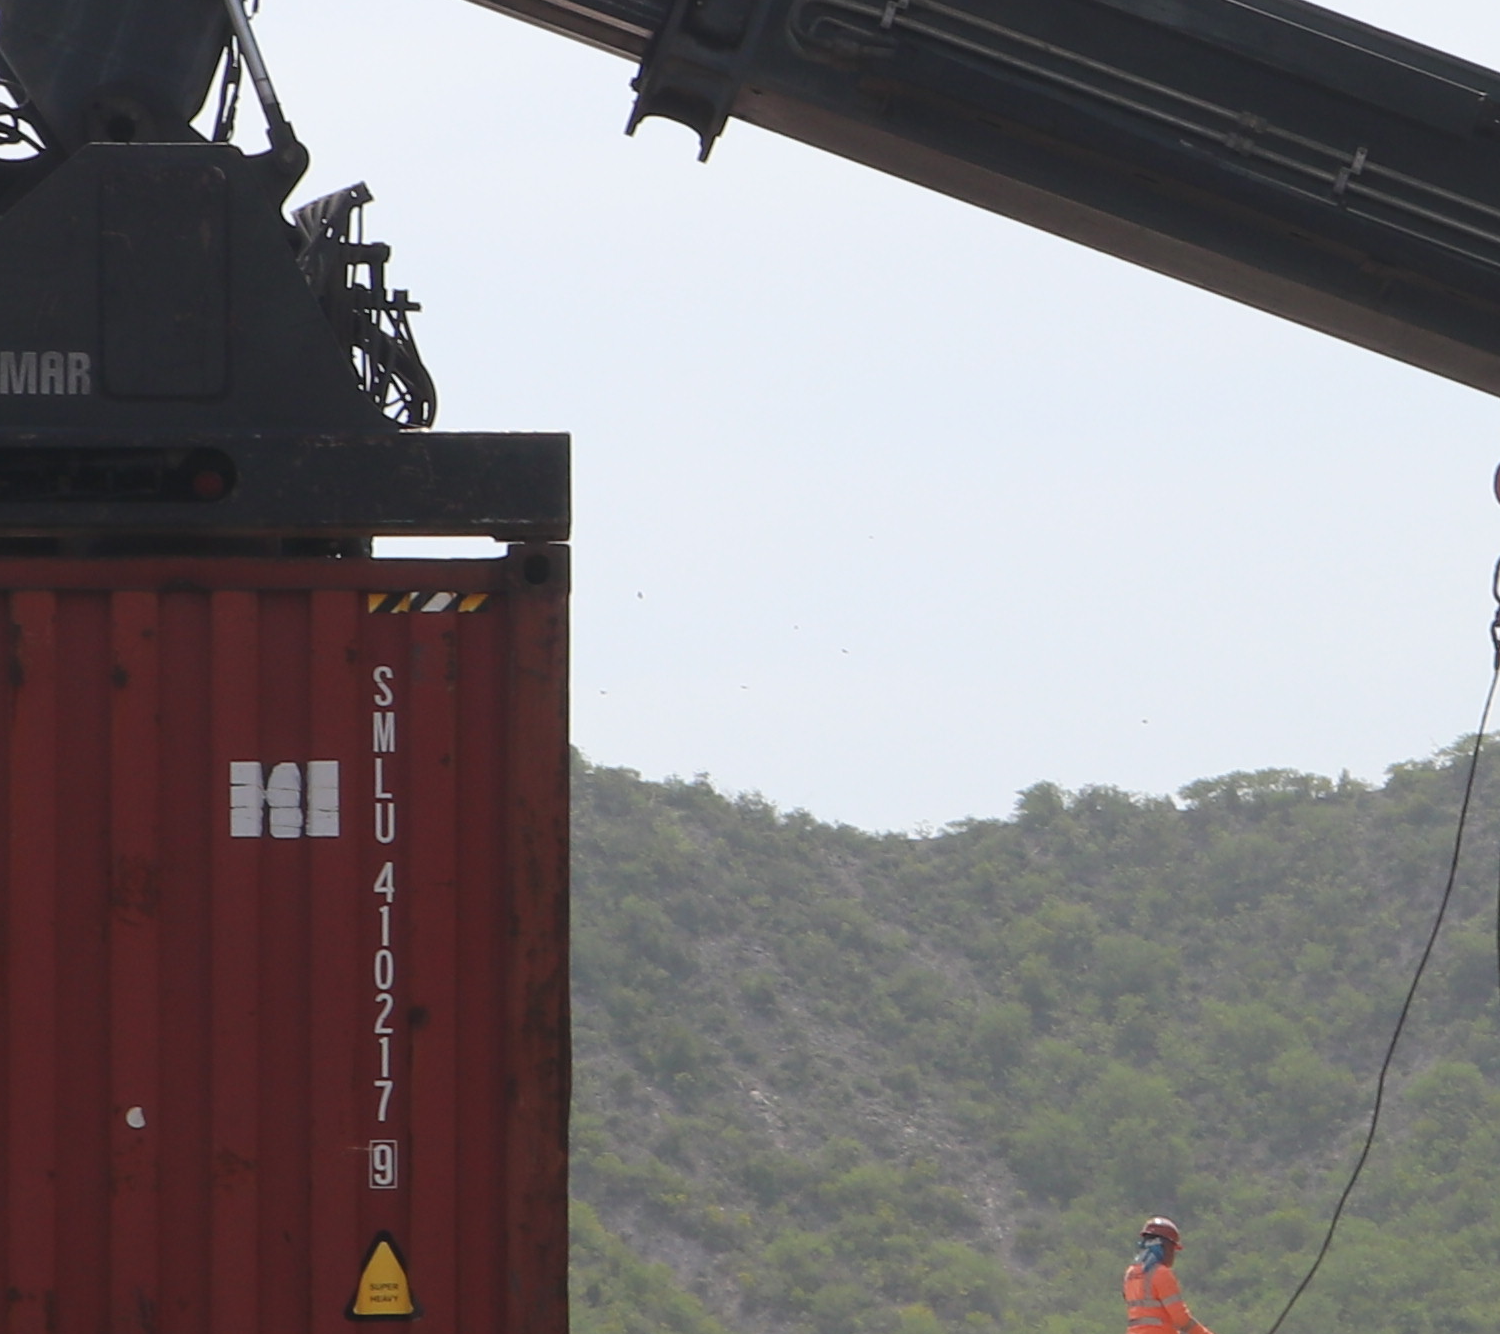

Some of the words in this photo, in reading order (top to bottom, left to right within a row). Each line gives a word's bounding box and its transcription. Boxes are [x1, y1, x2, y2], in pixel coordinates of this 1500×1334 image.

[371, 666, 396, 844] SMLU
[372, 861, 396, 1122] 410217
[373, 1143, 393, 1185] 9
[370, 1282, 398, 1291] SUPER
[370, 1295, 398, 1303] HEAVY
